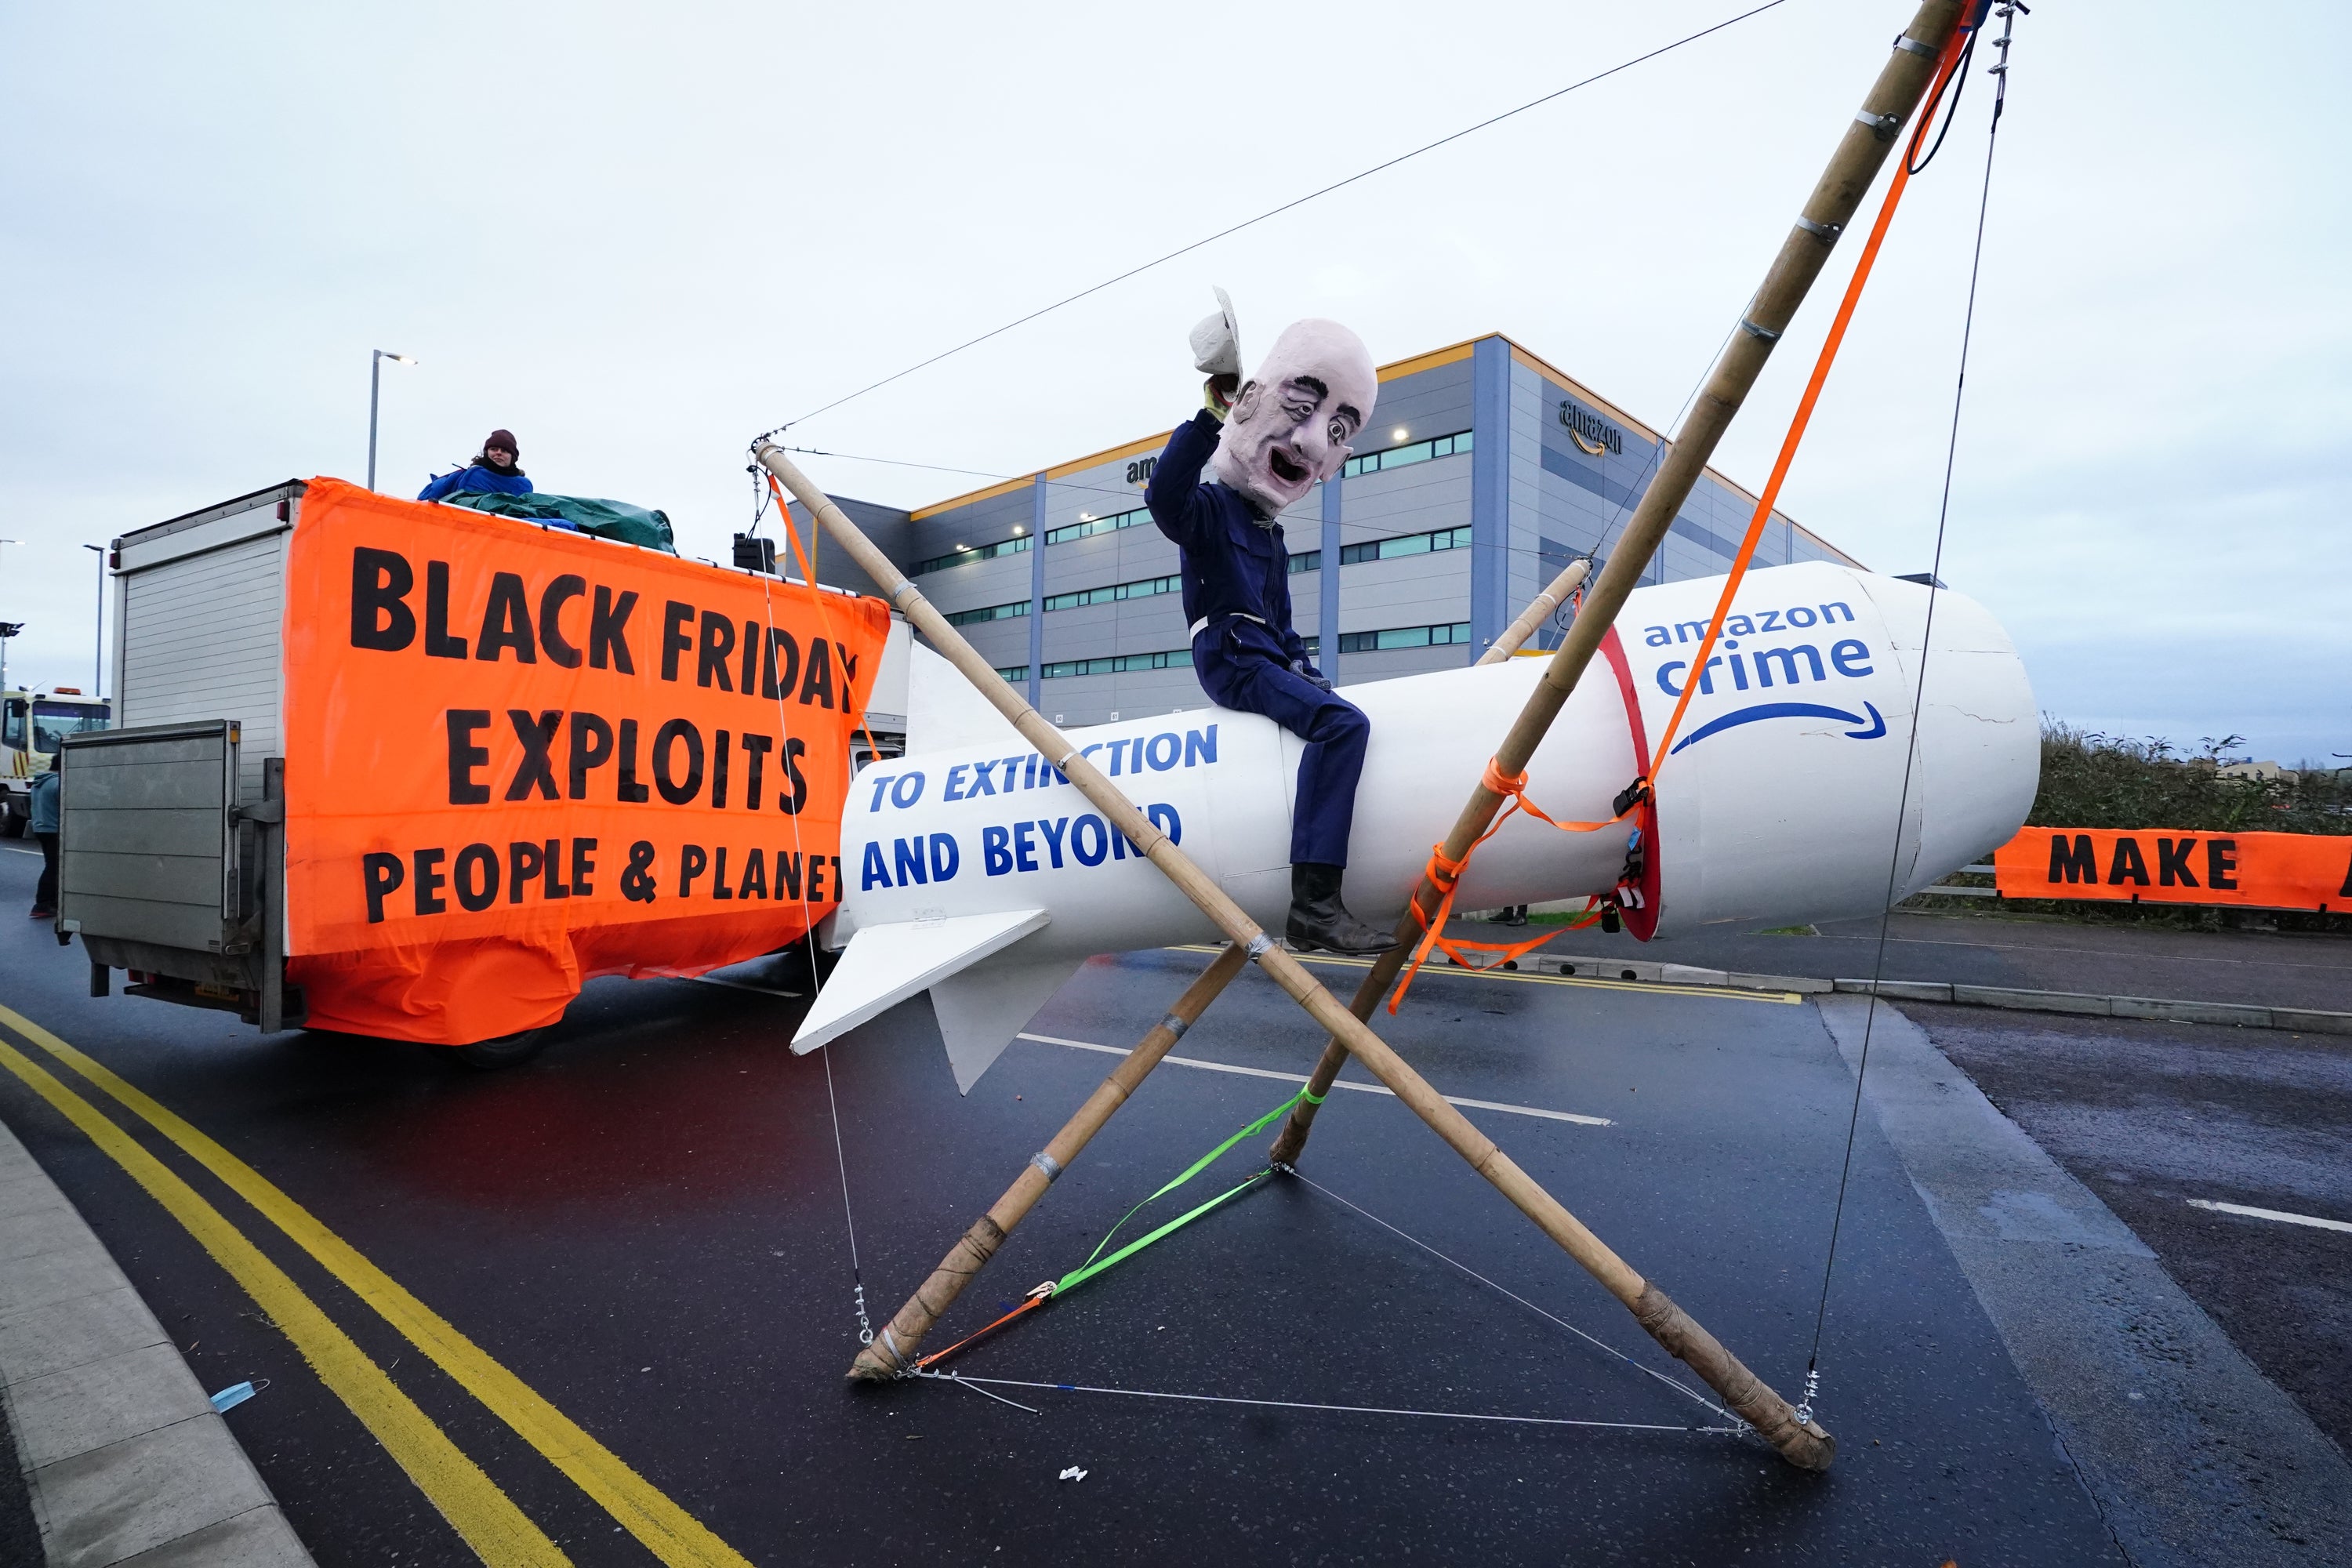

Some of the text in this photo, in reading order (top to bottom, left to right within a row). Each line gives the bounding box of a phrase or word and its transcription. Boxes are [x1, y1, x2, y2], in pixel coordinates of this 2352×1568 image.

[1560, 401, 1622, 455] amazon
[351, 547, 859, 714] BLACK FRIDAY
[1644, 601, 1856, 647] amazon
[1656, 639, 1874, 697] crime
[447, 710, 807, 815] EXPLOITS
[869, 724, 1218, 812] TO EXTITION
[363, 838, 843, 924] PEOPLE & PLANET
[862, 833, 960, 891] AND
[2048, 834, 2239, 890] MAKE
